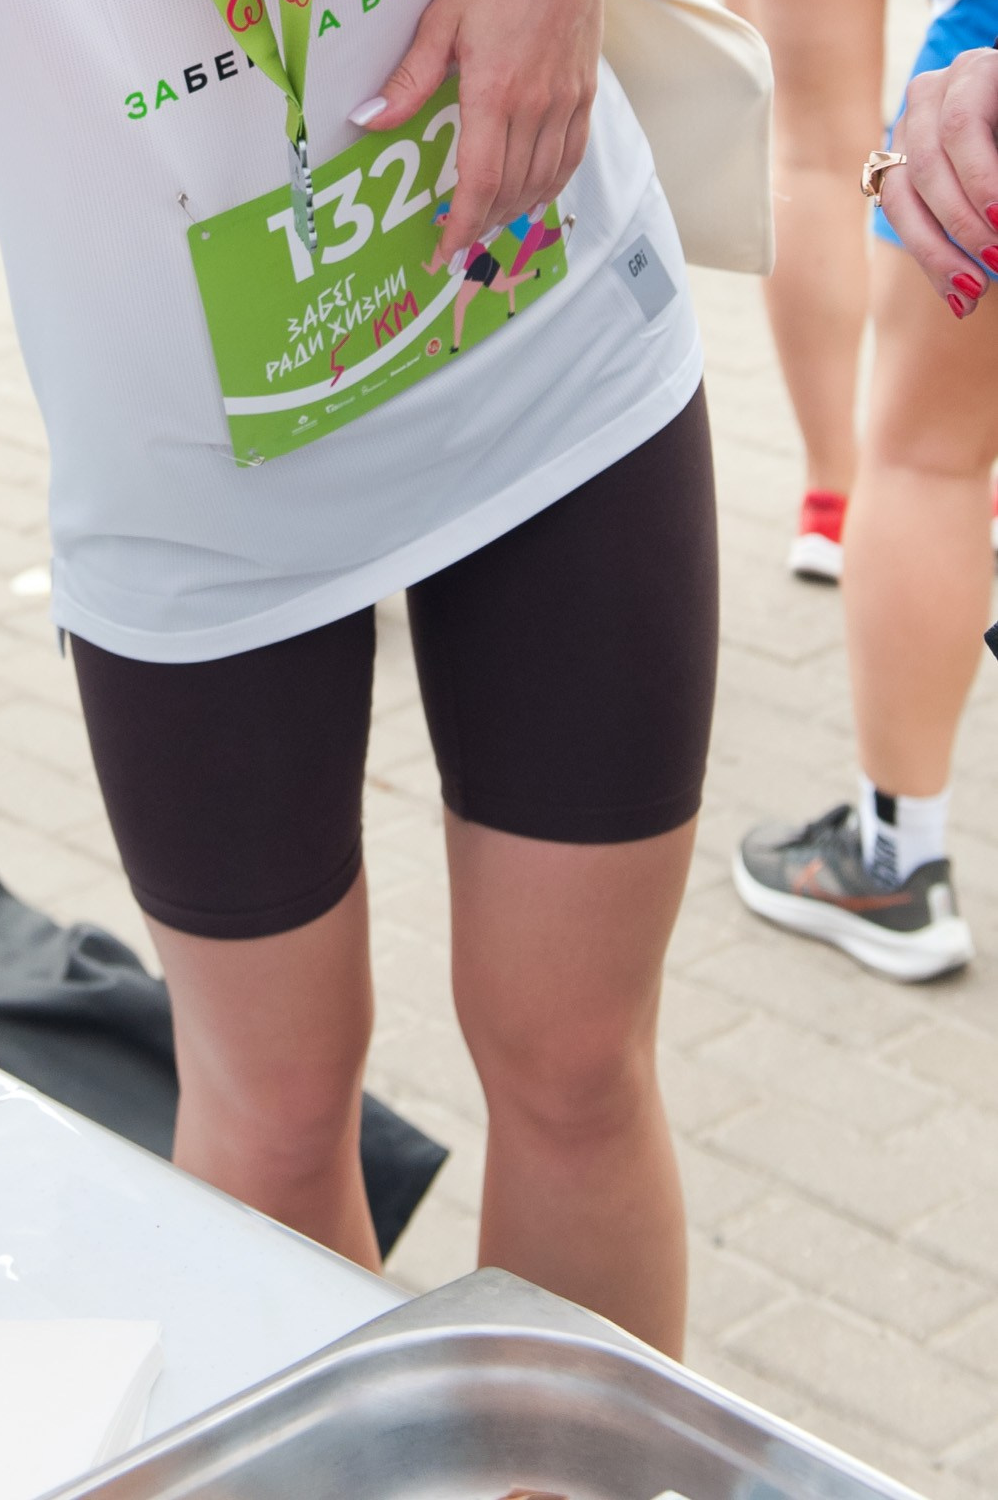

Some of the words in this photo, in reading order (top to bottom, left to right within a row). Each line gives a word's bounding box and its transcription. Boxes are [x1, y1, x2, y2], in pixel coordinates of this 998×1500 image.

[265, 333, 325, 382] РАДИ
[327, 266, 407, 341] ЖИЗНИ
[288, 273, 357, 341] ЗАБЕГ
[329, 335, 351, 387] 5
[373, 291, 420, 350] КМ
